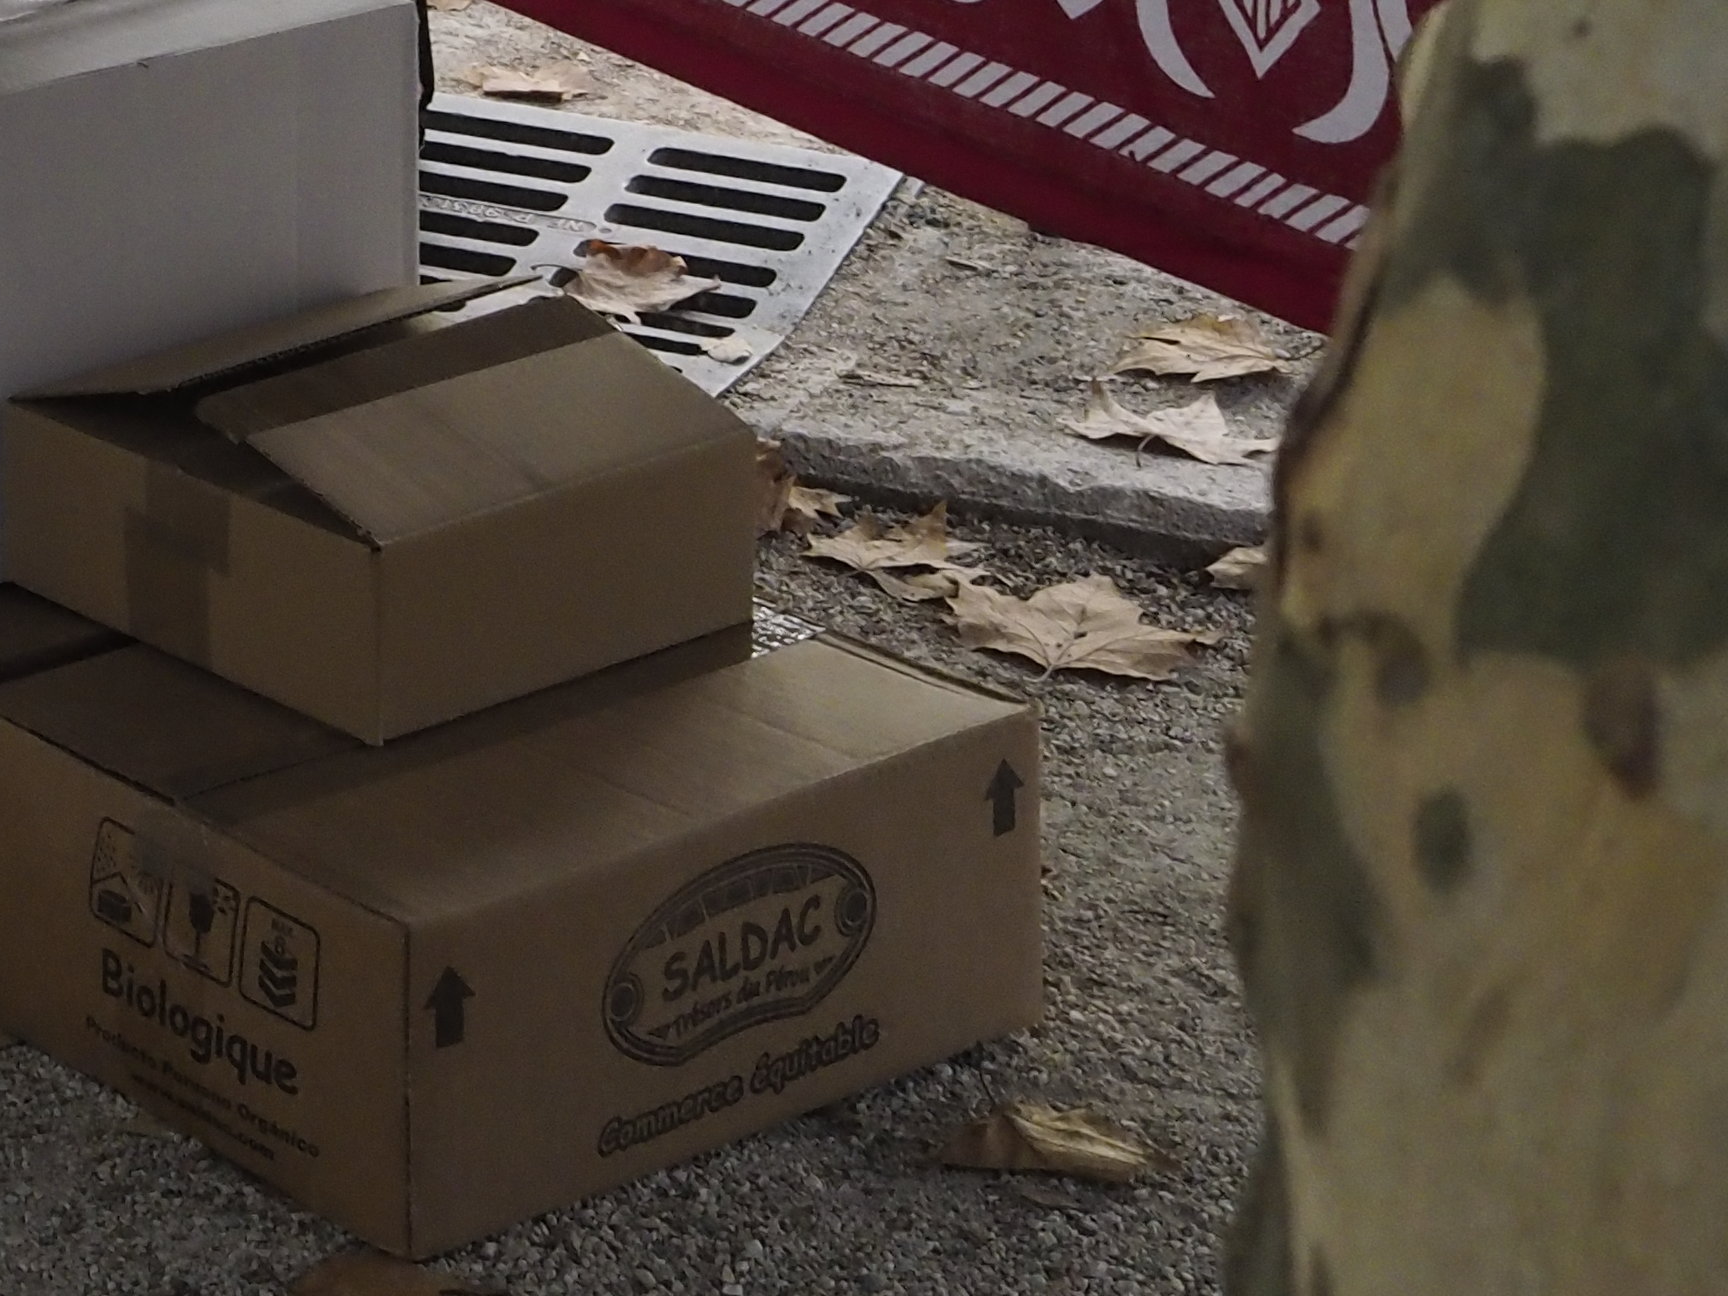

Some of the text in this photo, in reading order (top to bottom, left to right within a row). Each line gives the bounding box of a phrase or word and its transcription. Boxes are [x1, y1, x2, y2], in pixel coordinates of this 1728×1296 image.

[662, 894, 823, 1003] SALDAC
[736, 976, 761, 1005] du
[101, 947, 299, 1096] Biologique
[597, 1013, 881, 1158] Commerce équitable
